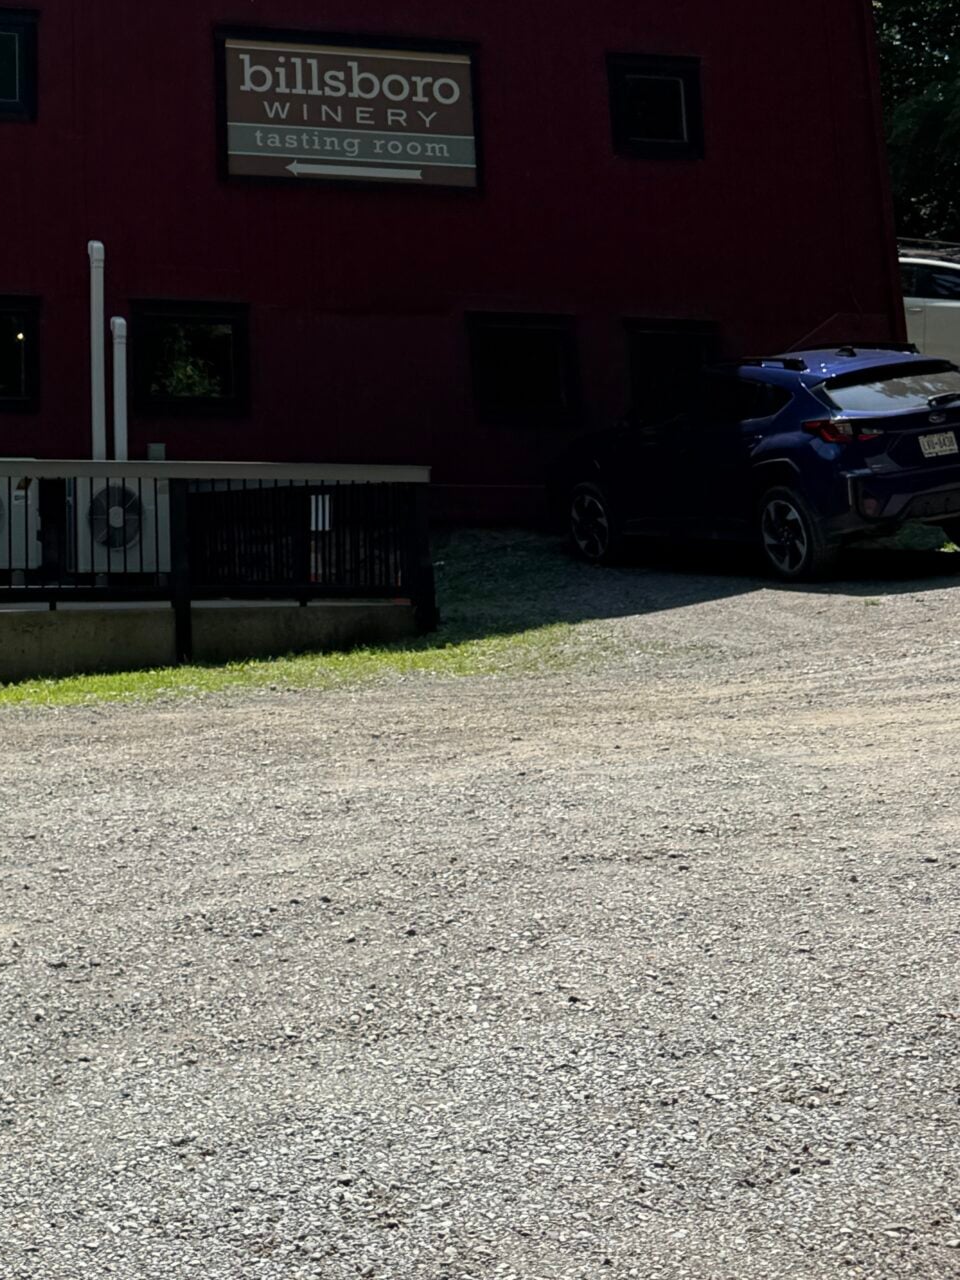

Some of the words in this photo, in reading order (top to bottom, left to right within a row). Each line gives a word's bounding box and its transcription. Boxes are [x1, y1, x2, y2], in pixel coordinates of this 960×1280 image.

[239, 54, 460, 105] billsboro
[263, 101, 437, 128] WINERY
[254, 129, 360, 157] tasting
[373, 139, 449, 157] room
